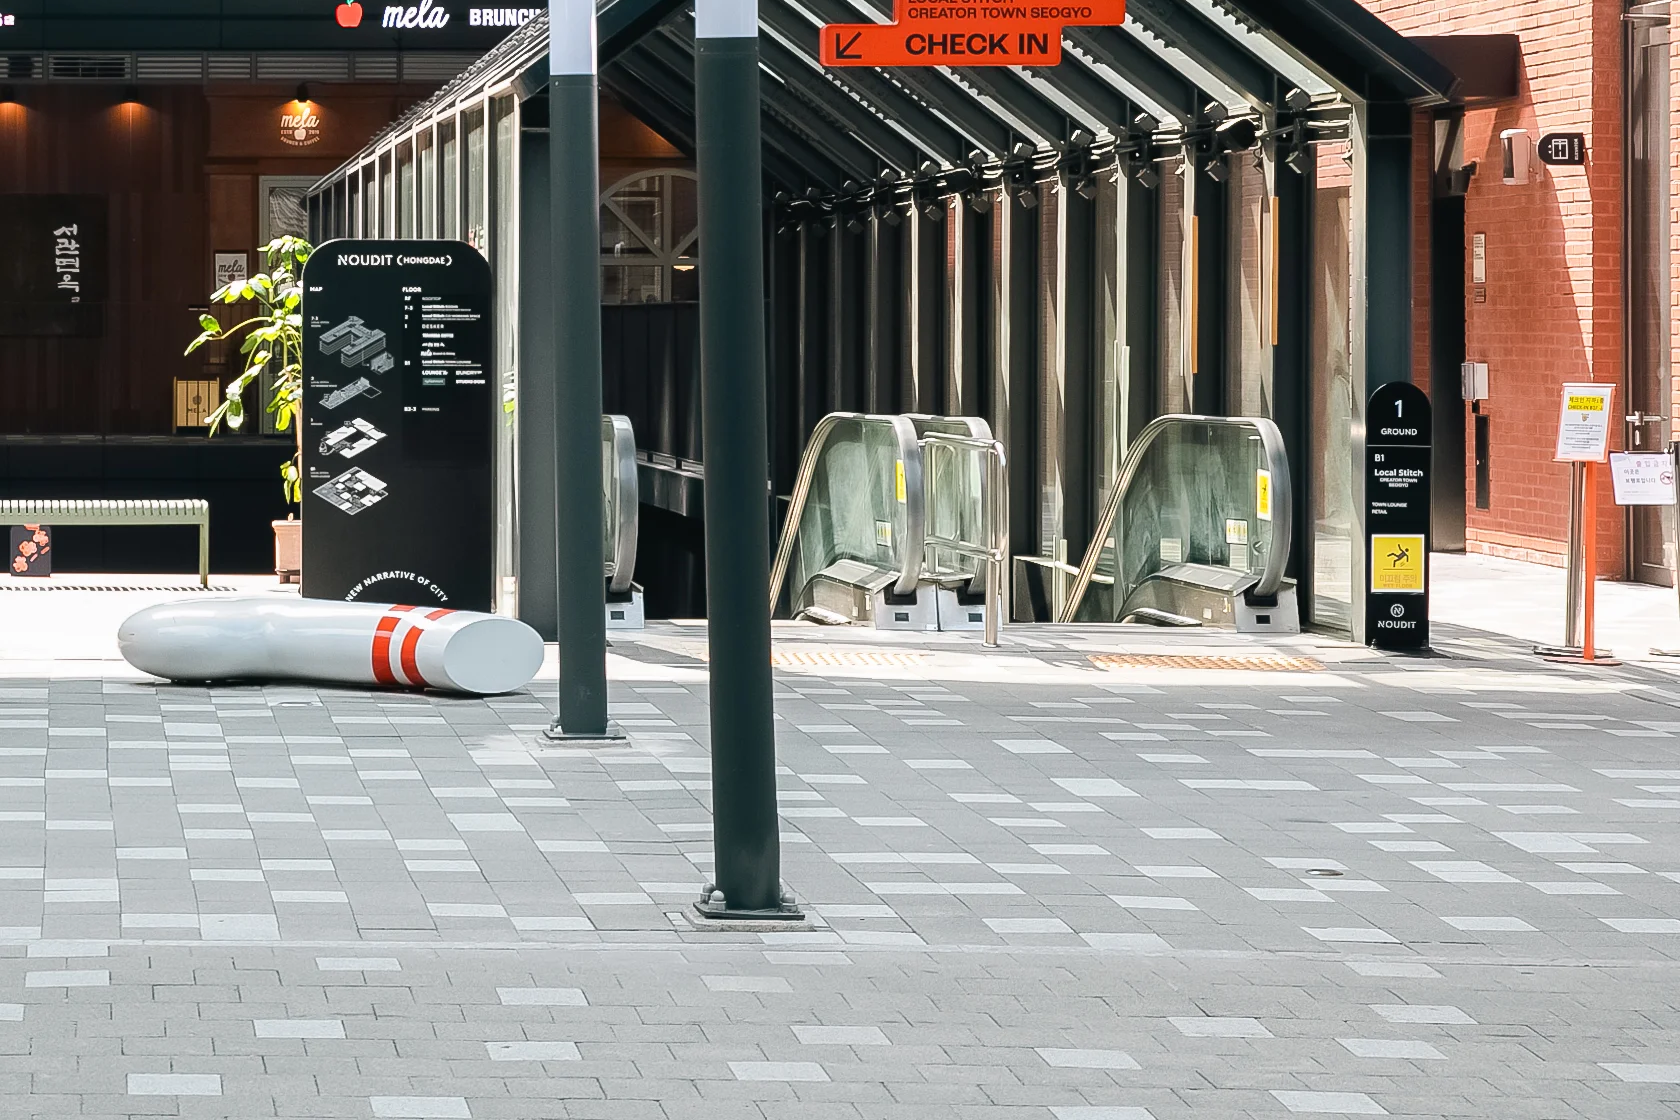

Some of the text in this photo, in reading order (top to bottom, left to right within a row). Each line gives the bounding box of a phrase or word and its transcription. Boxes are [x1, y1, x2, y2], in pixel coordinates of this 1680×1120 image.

[908, 7, 1092, 19] CREATOR TOWN SEOGYO
[905, 33, 1049, 55] CHECK IN
[280, 107, 320, 128] mela
[218, 259, 245, 273] mela
[337, 254, 453, 267] NOUDIT (HONGDAE)
[1394, 399, 1403, 418] 1
[1380, 427, 1418, 436] GROUND
[1374, 453, 1385, 462] B1
[1374, 468, 1424, 477] Local Stitch
[345, 570, 449, 602] NEW NARRATIVE OF CITY
[1377, 620, 1417, 629] NOUDIT
